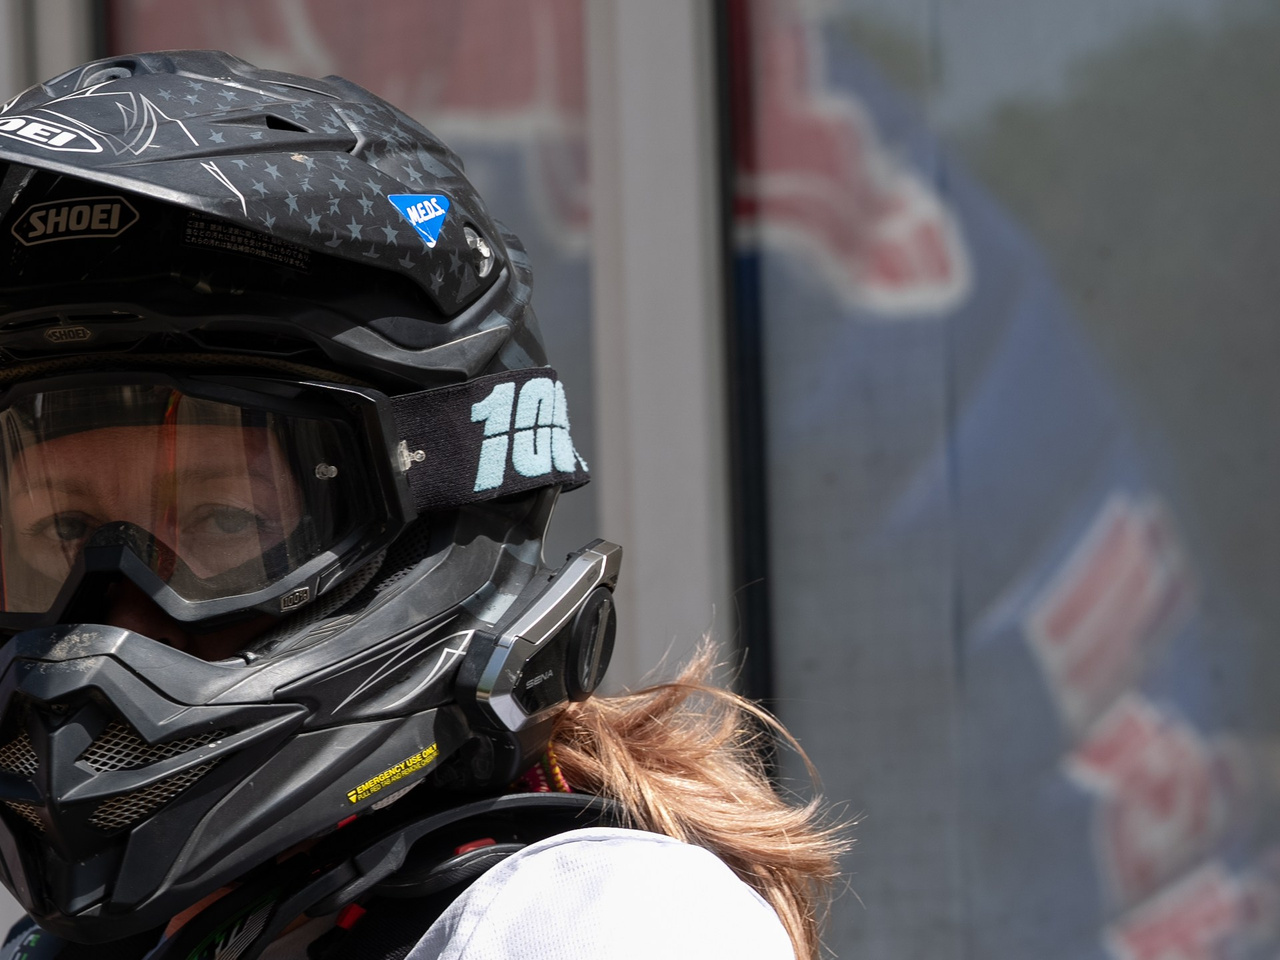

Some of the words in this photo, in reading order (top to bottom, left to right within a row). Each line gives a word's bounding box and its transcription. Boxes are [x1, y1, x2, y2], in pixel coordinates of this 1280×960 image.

[28, 203, 122, 239] SHOEI
[50, 328, 88, 342] SHOEI
[283, 589, 308, 607] 100%
[525, 669, 554, 690] SENA
[356, 761, 407, 794] EMERGENCY
[406, 753, 422, 767] USE
[422, 742, 438, 758] ONLY
[357, 790, 371, 801] PULL
[370, 783, 382, 793] RED
[380, 777, 392, 788] TAB
[391, 771, 402, 782] AND
[401, 763, 422, 777] REMOVE
